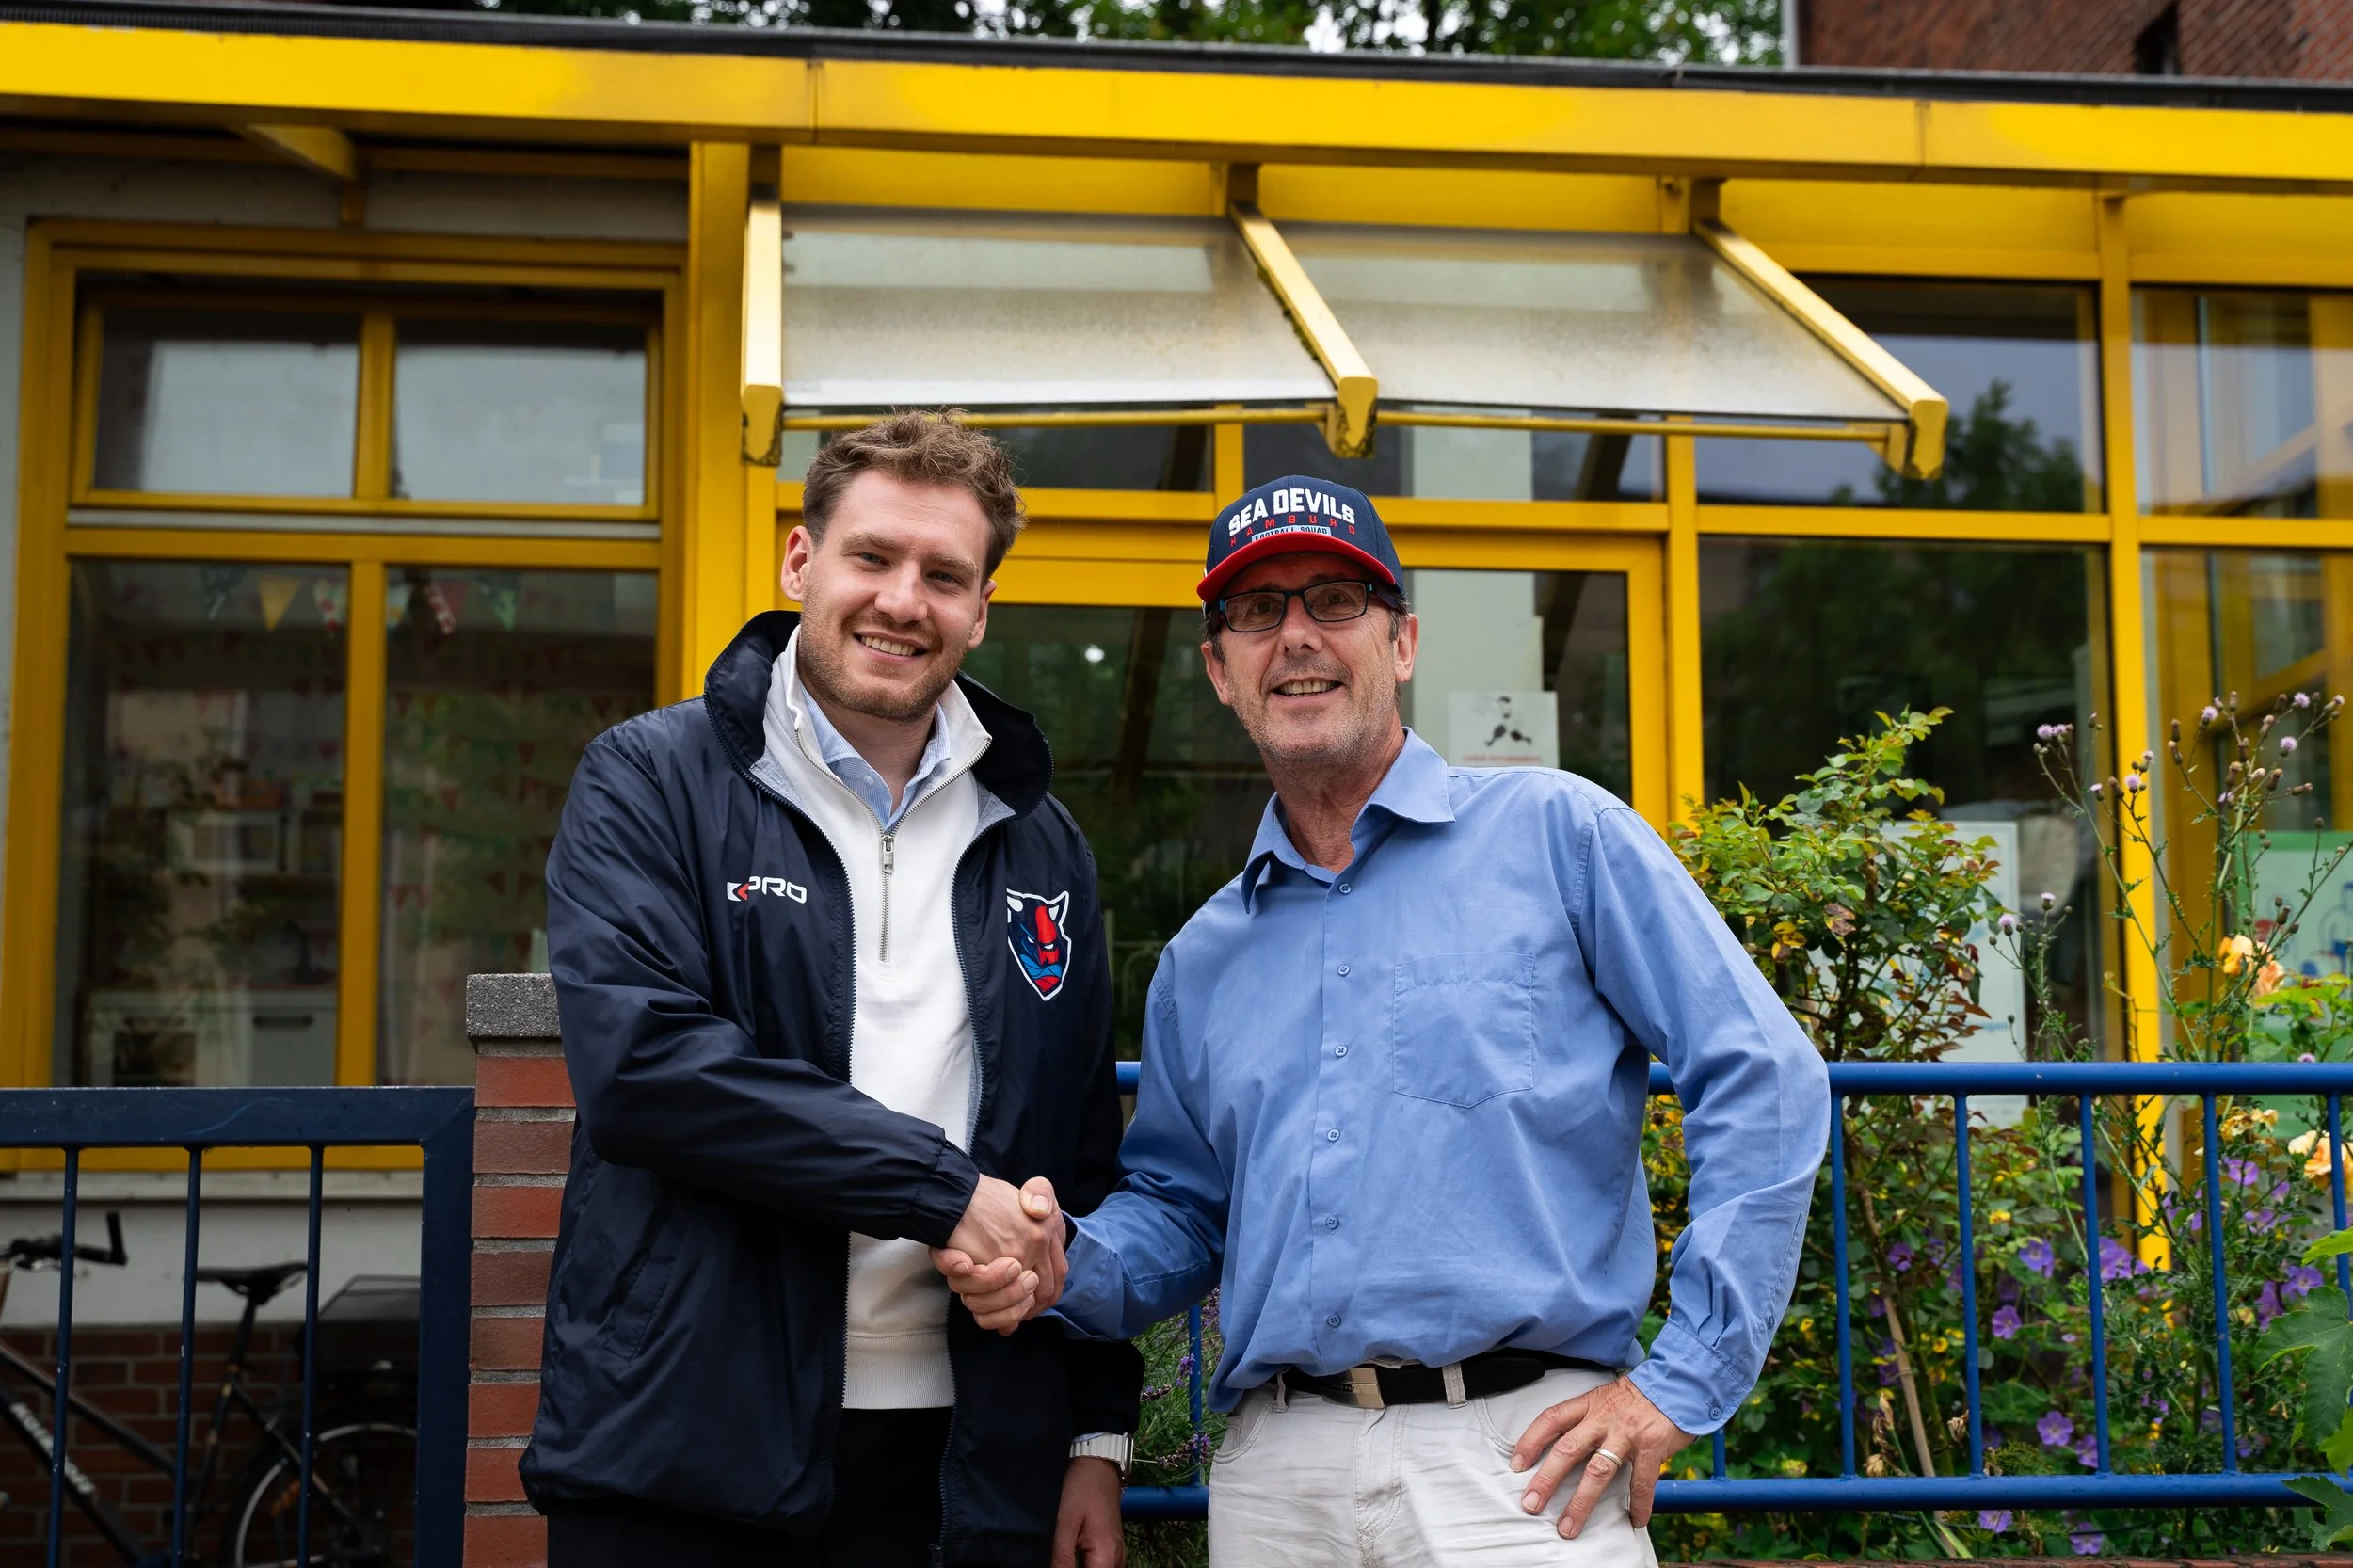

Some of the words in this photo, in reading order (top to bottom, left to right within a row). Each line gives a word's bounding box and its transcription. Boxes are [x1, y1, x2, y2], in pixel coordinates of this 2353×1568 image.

[1228, 497, 1269, 537] SEA
[1273, 488, 1355, 525] DEVILS
[1230, 514, 1355, 547] HAMBURG
